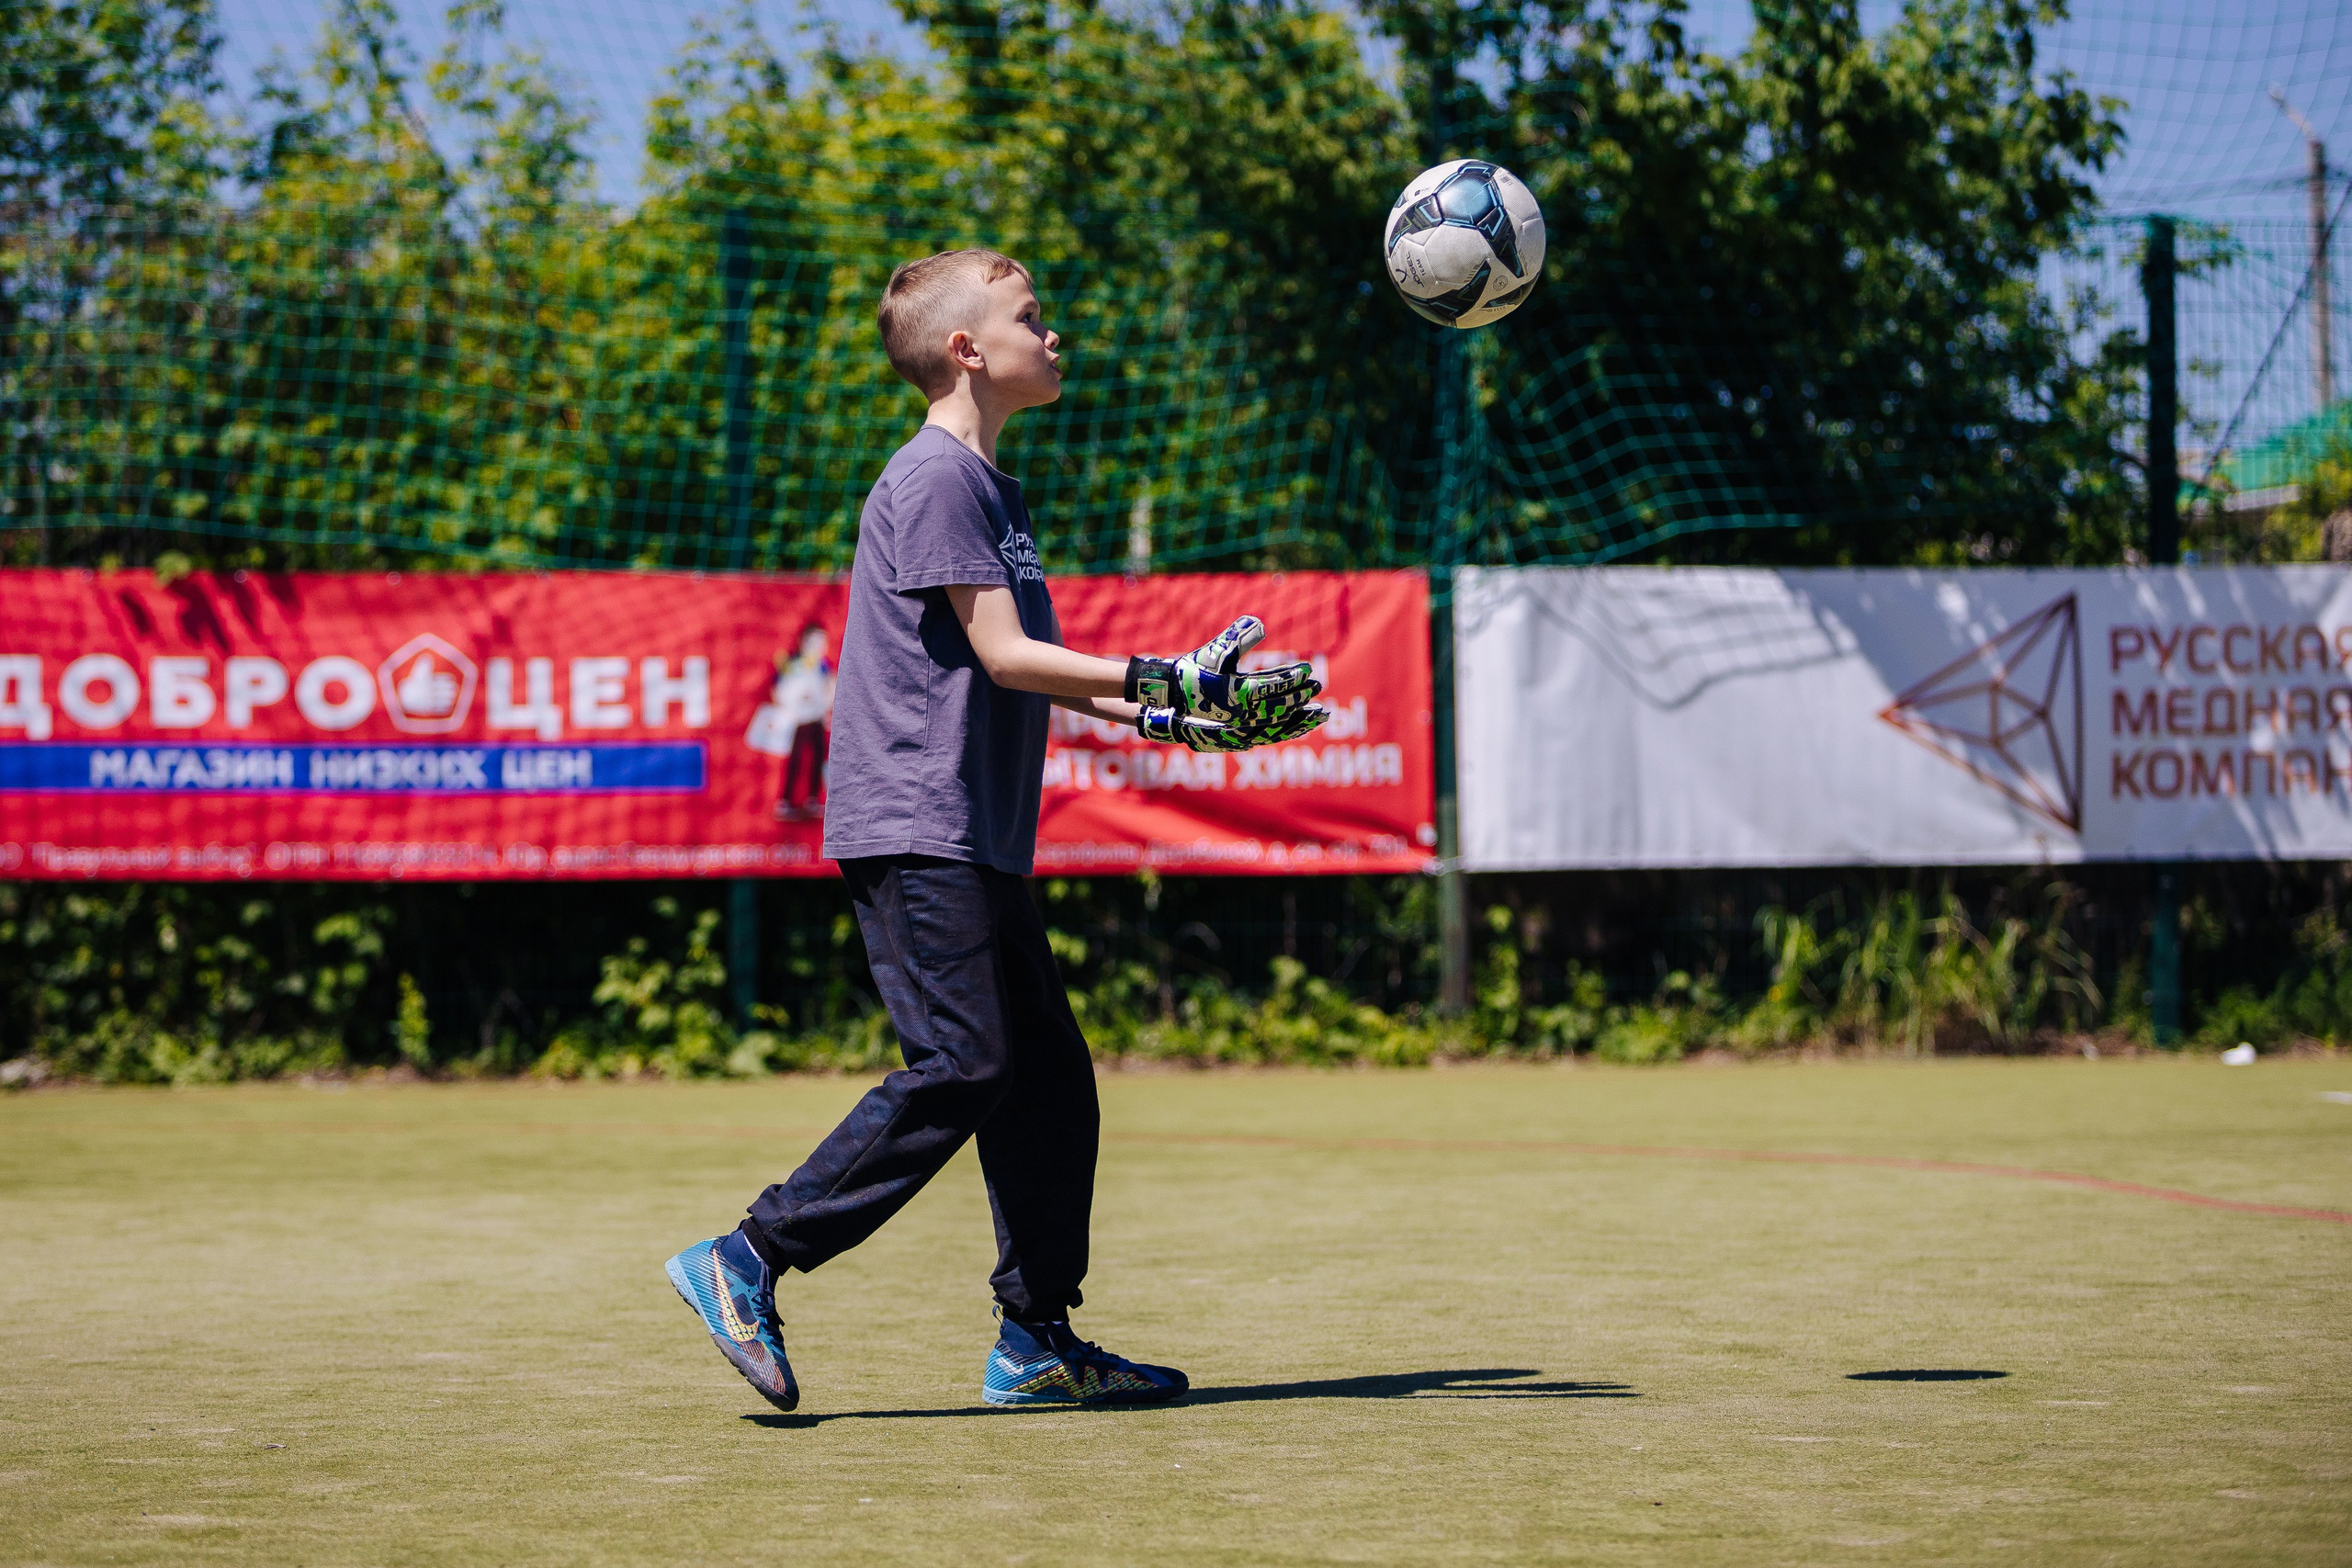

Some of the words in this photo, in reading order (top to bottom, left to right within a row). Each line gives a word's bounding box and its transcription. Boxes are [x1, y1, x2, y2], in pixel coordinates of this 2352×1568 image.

[1416, 258, 1427, 276] TEAM
[0, 653, 378, 741] ДОБРО
[485, 656, 711, 741] ЦЕН
[2110, 686, 2352, 736] МЕДНАЯ
[92, 750, 294, 789] МАГАЗИН
[310, 750, 487, 789] НИЗКИХ
[501, 750, 593, 793] ЦЕН
[1043, 748, 1226, 790] ЫТОВАЯ
[1232, 744, 1403, 790] ХИМИЯ
